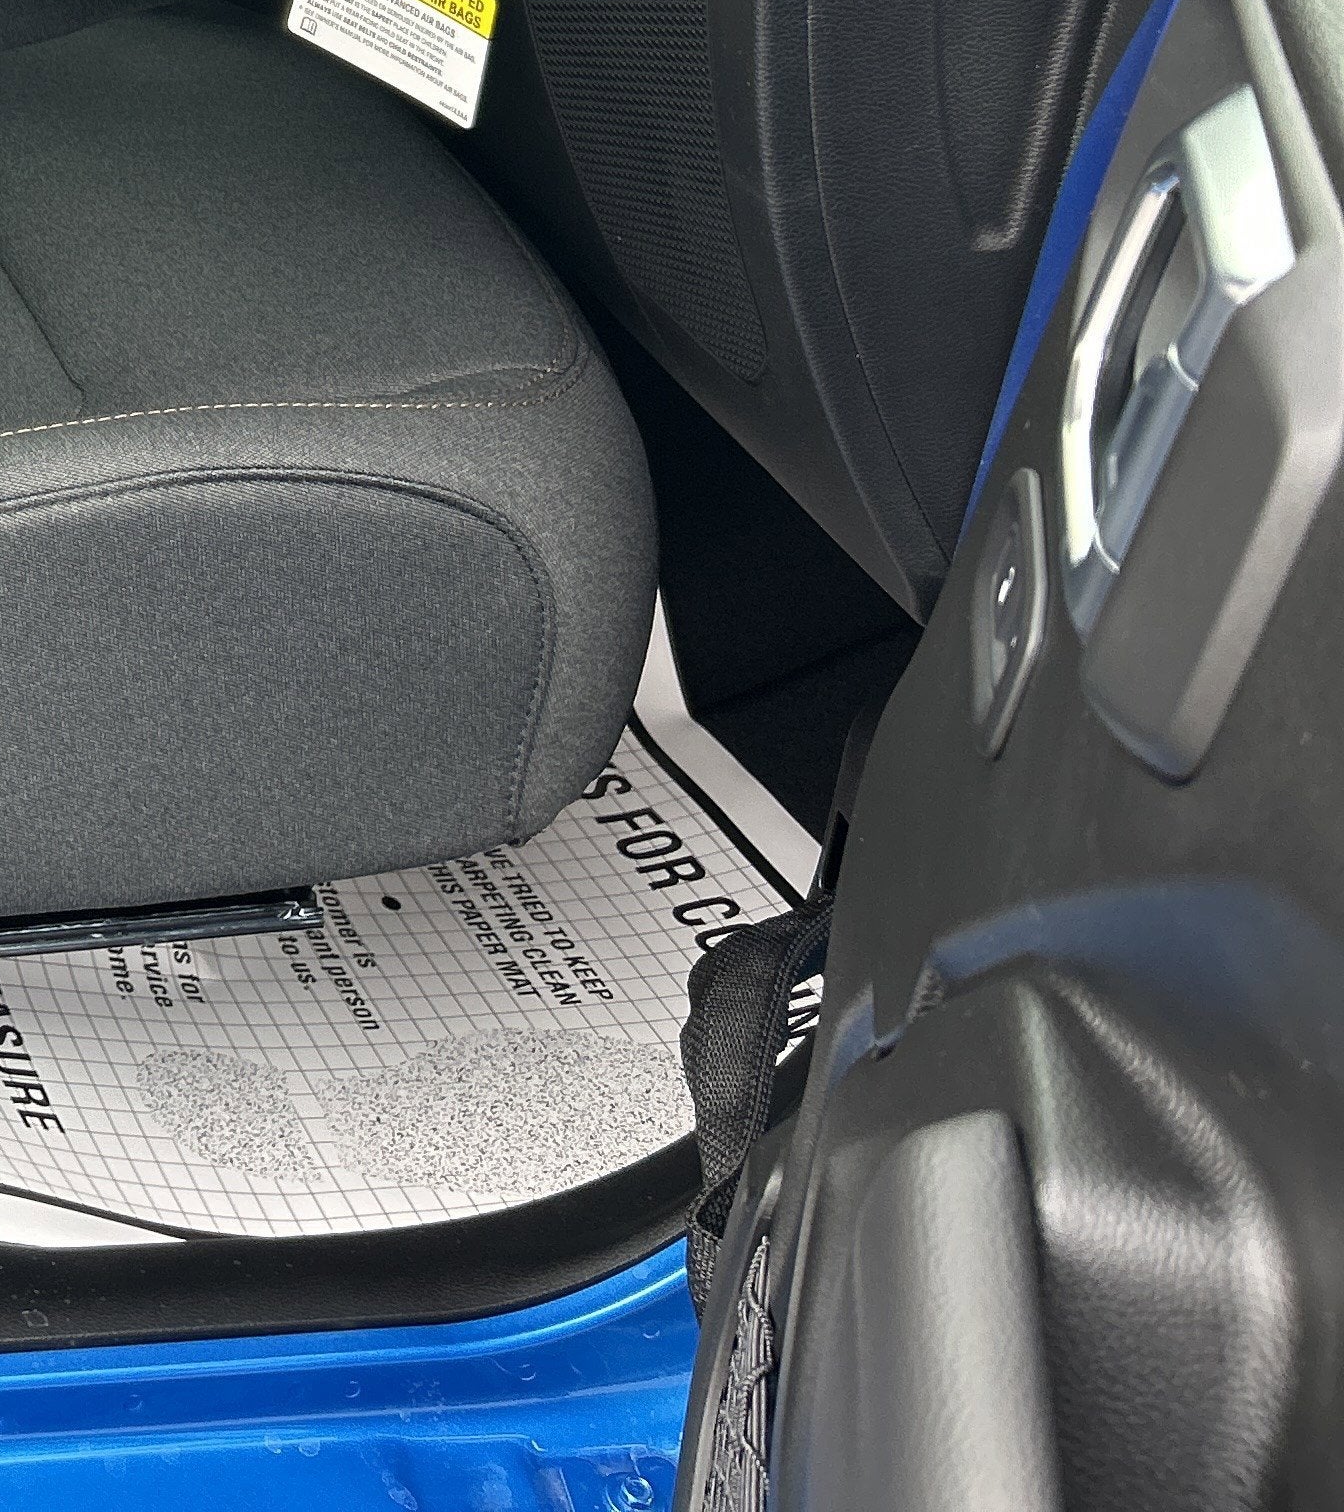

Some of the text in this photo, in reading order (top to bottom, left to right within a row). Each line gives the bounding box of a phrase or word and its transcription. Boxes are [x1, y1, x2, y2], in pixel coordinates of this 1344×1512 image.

[421, 11, 435, 26] AIR
[434, 19, 456, 39] BAGS
[449, 1, 482, 29] BAGS
[594, 806, 708, 891] FOR
[316, 882, 365, 946] tomer
[352, 950, 379, 968] is
[427, 862, 542, 999] HIS PAPER MAT
[454, 857, 582, 1005] ARPETING CLEAN
[482, 847, 613, 999] VE TRIED TO KEEP
[142, 944, 173, 1007] rvice
[176, 974, 208, 1004] for
[277, 935, 318, 991] to us.
[320, 962, 379, 1030] person
